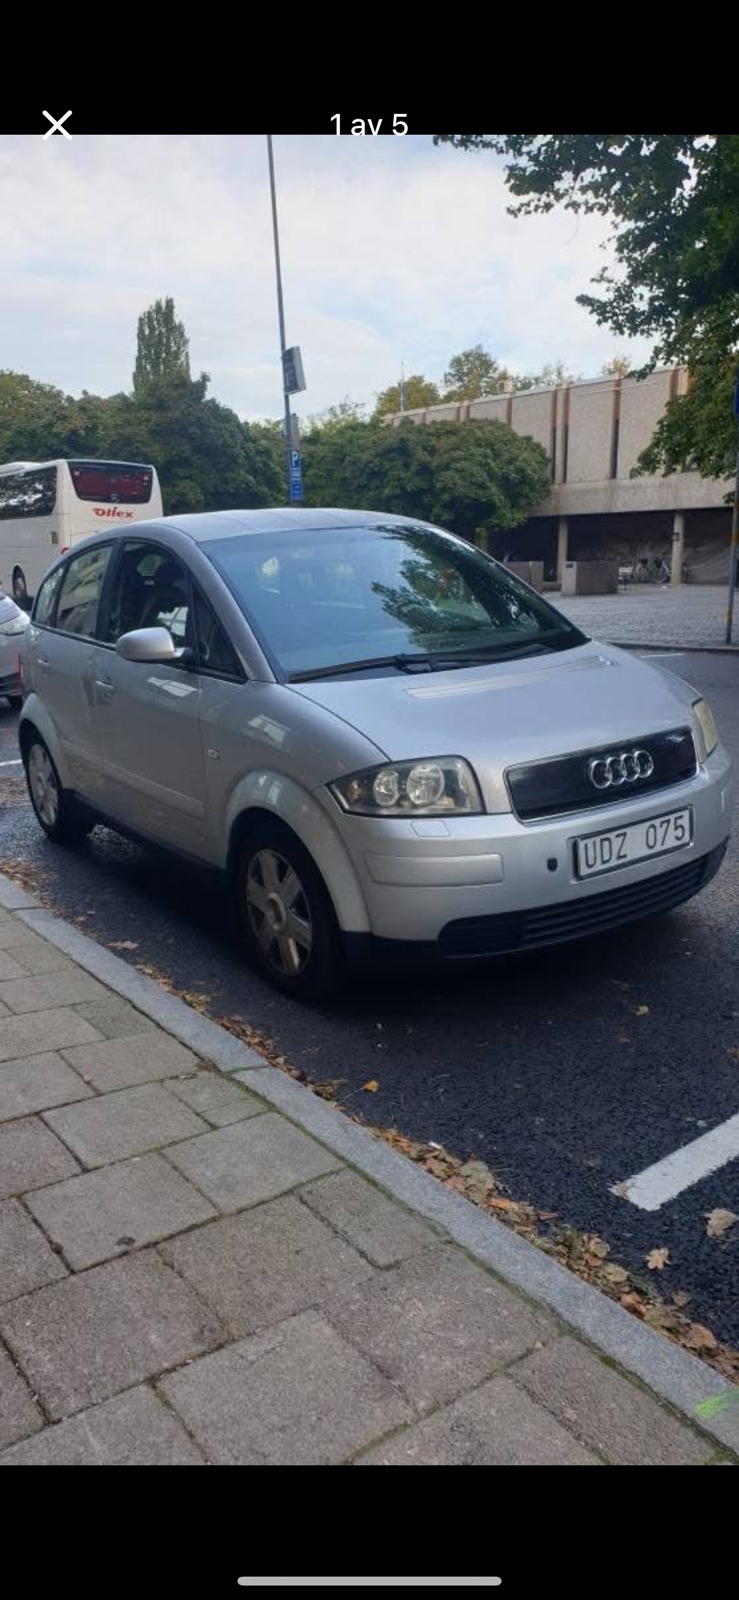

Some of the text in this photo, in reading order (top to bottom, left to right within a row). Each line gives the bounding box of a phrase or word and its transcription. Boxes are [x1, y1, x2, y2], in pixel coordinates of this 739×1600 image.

[291, 451, 298, 467] P
[584, 815, 686, 869] UDZ 075
